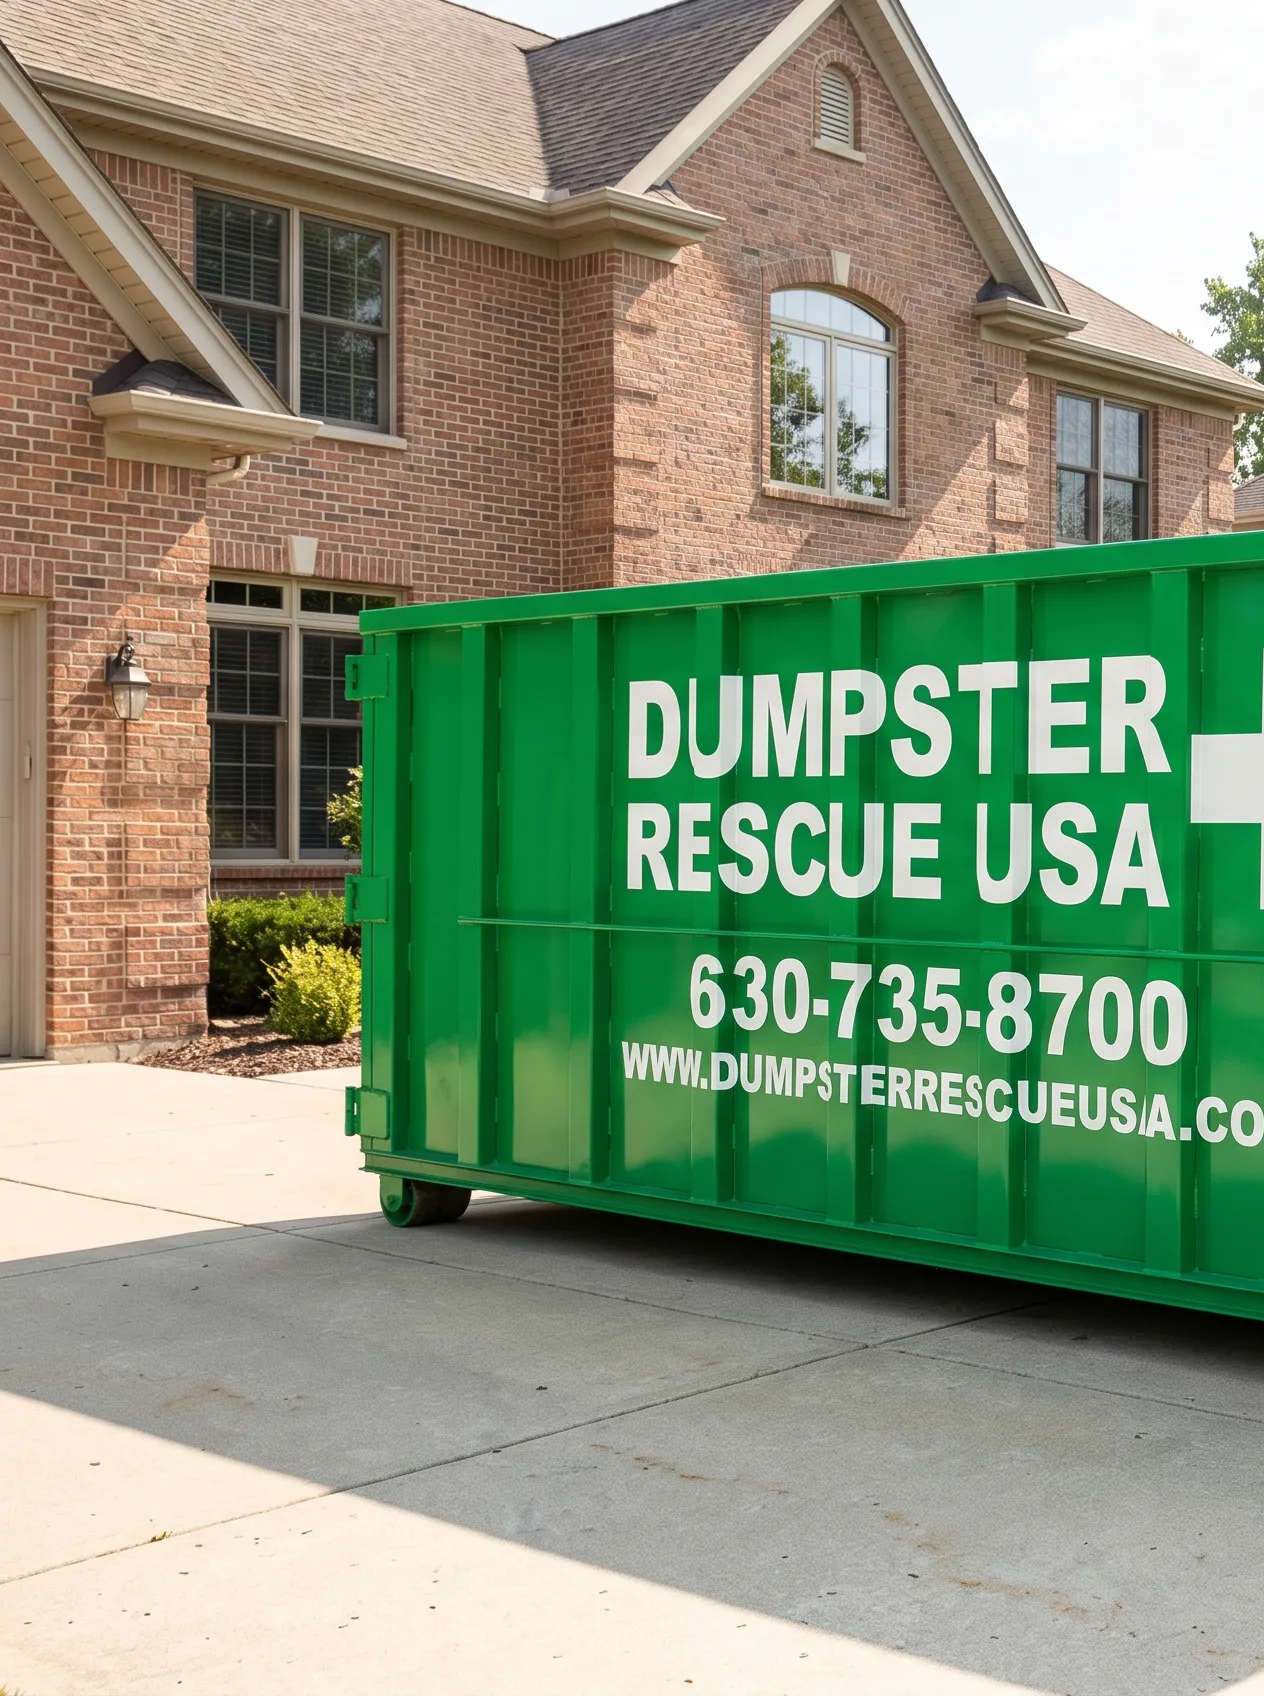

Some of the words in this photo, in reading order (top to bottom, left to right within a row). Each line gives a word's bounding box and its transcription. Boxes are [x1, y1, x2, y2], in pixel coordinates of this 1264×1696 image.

[626, 654, 1172, 780] DUMPSTER
[625, 801, 942, 900] RESCUE
[976, 801, 1170, 908] USA
[690, 953, 1188, 1067] 630-735-8700
